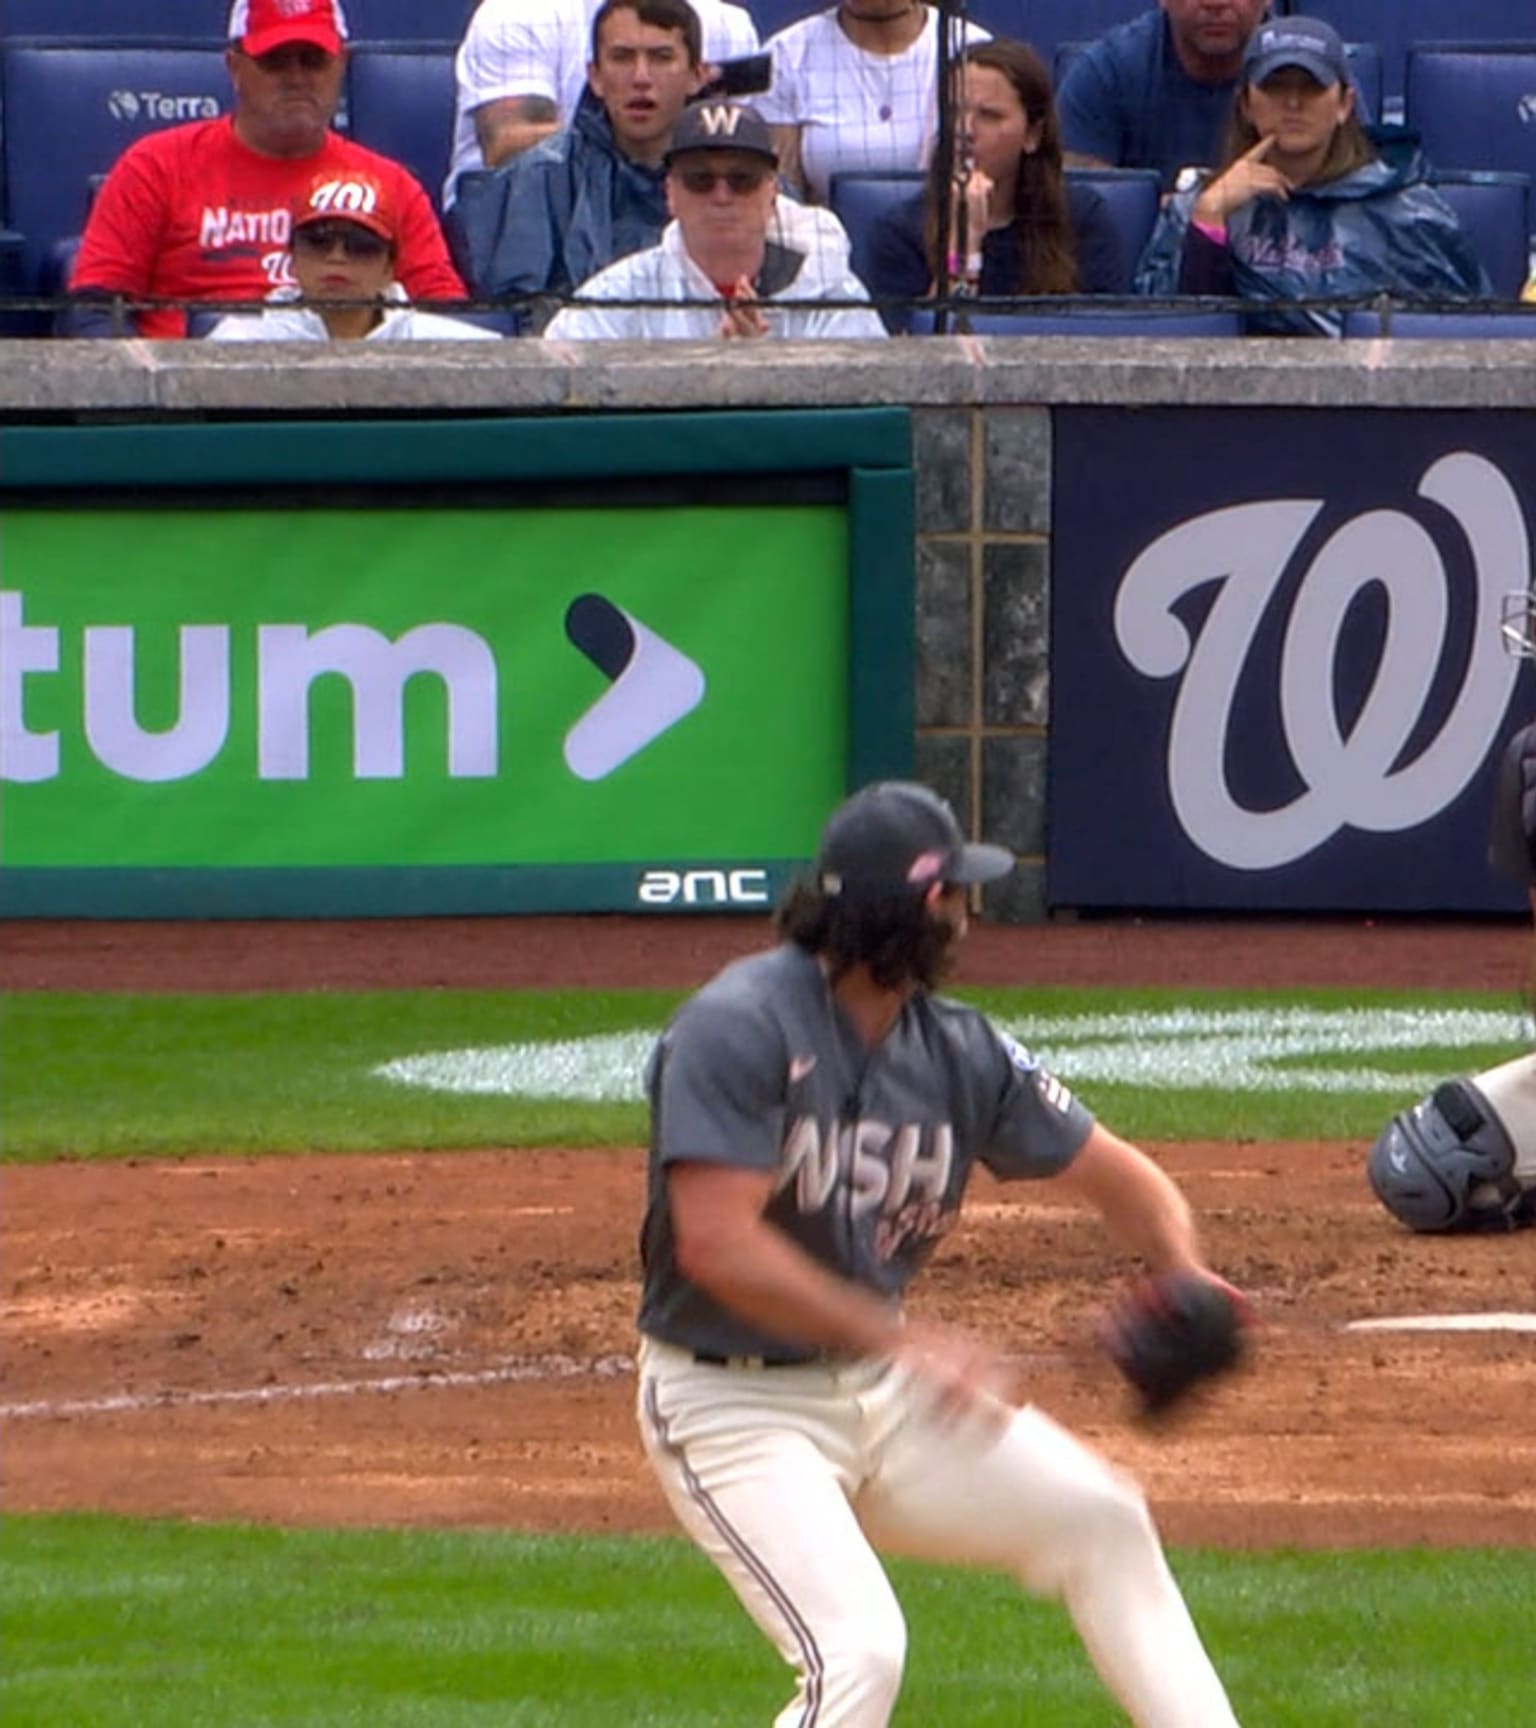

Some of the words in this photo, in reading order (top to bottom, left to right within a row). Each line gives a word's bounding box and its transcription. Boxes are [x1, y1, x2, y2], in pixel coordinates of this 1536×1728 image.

[139, 91, 220, 119] Terra
[701, 105, 741, 135] W
[199, 206, 293, 248] NATIO
[1113, 450, 1530, 871] W
[638, 869, 768, 903] anc
